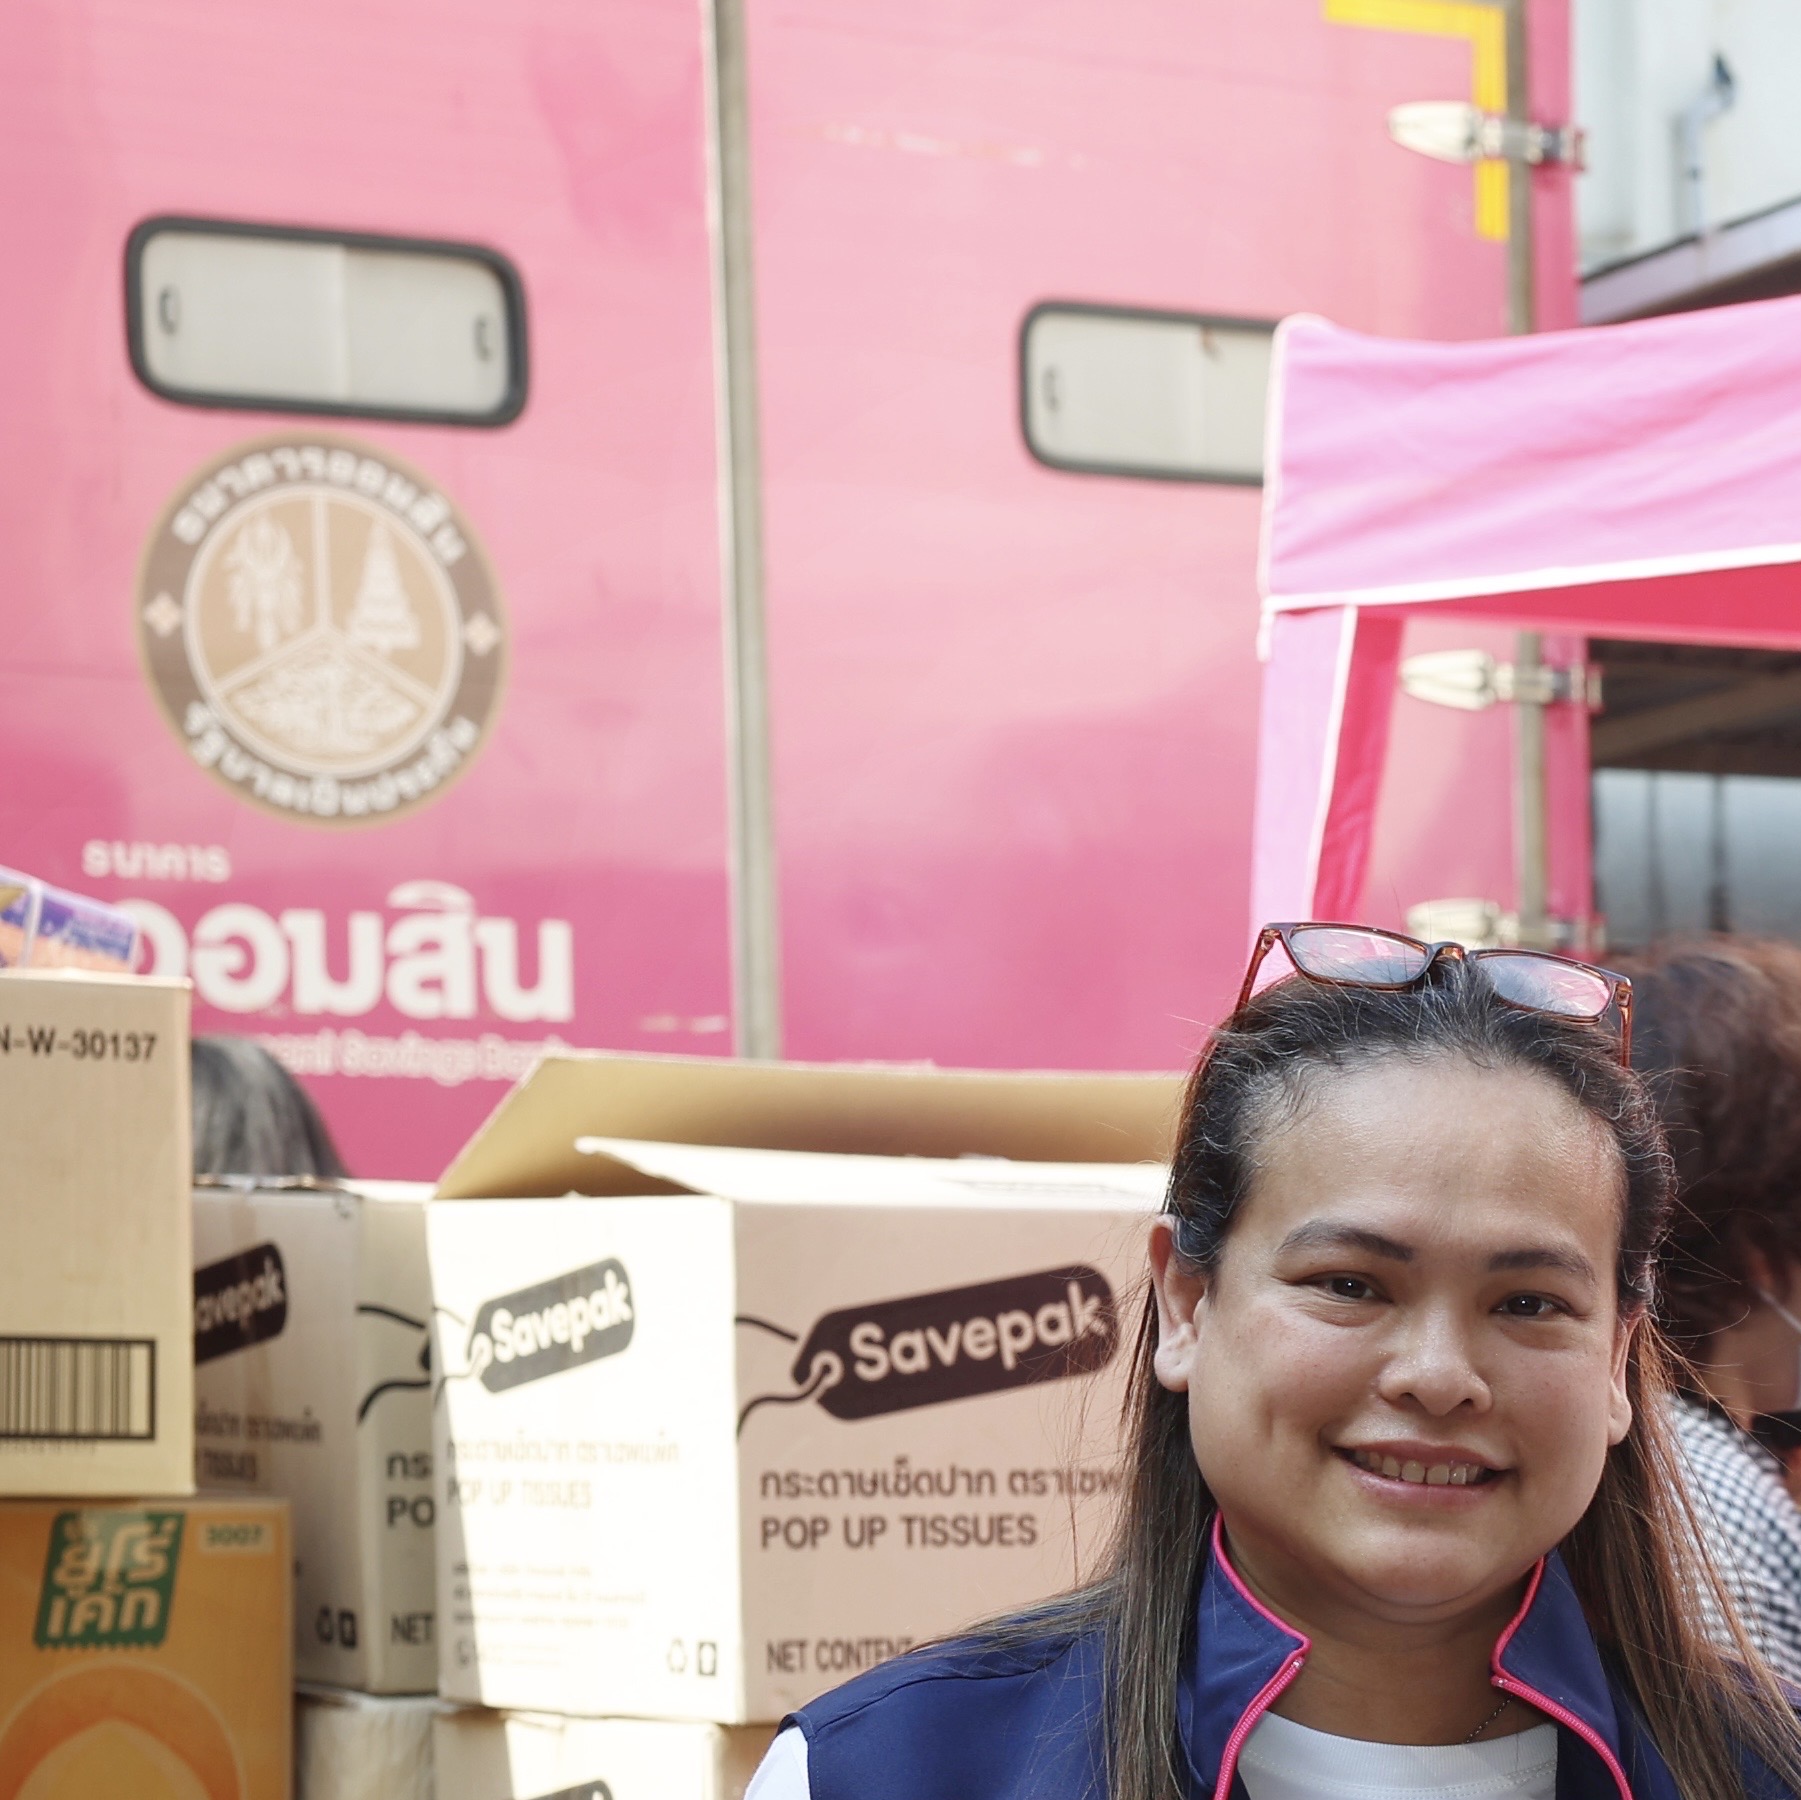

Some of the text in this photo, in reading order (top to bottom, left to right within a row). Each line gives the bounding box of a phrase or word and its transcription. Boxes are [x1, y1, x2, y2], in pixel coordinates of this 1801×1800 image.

[83, 840, 231, 883] ธนาคาร
[196, 1254, 284, 1332] avepak
[489, 1274, 632, 1363] Savepak
[849, 1281, 1107, 1383] Savepak
[760, 1456, 996, 1500] กระดาษเช็ดปาก
[760, 1513, 1038, 1552] POP UP TISSUES
[766, 1636, 914, 1675] NET CONTEN
